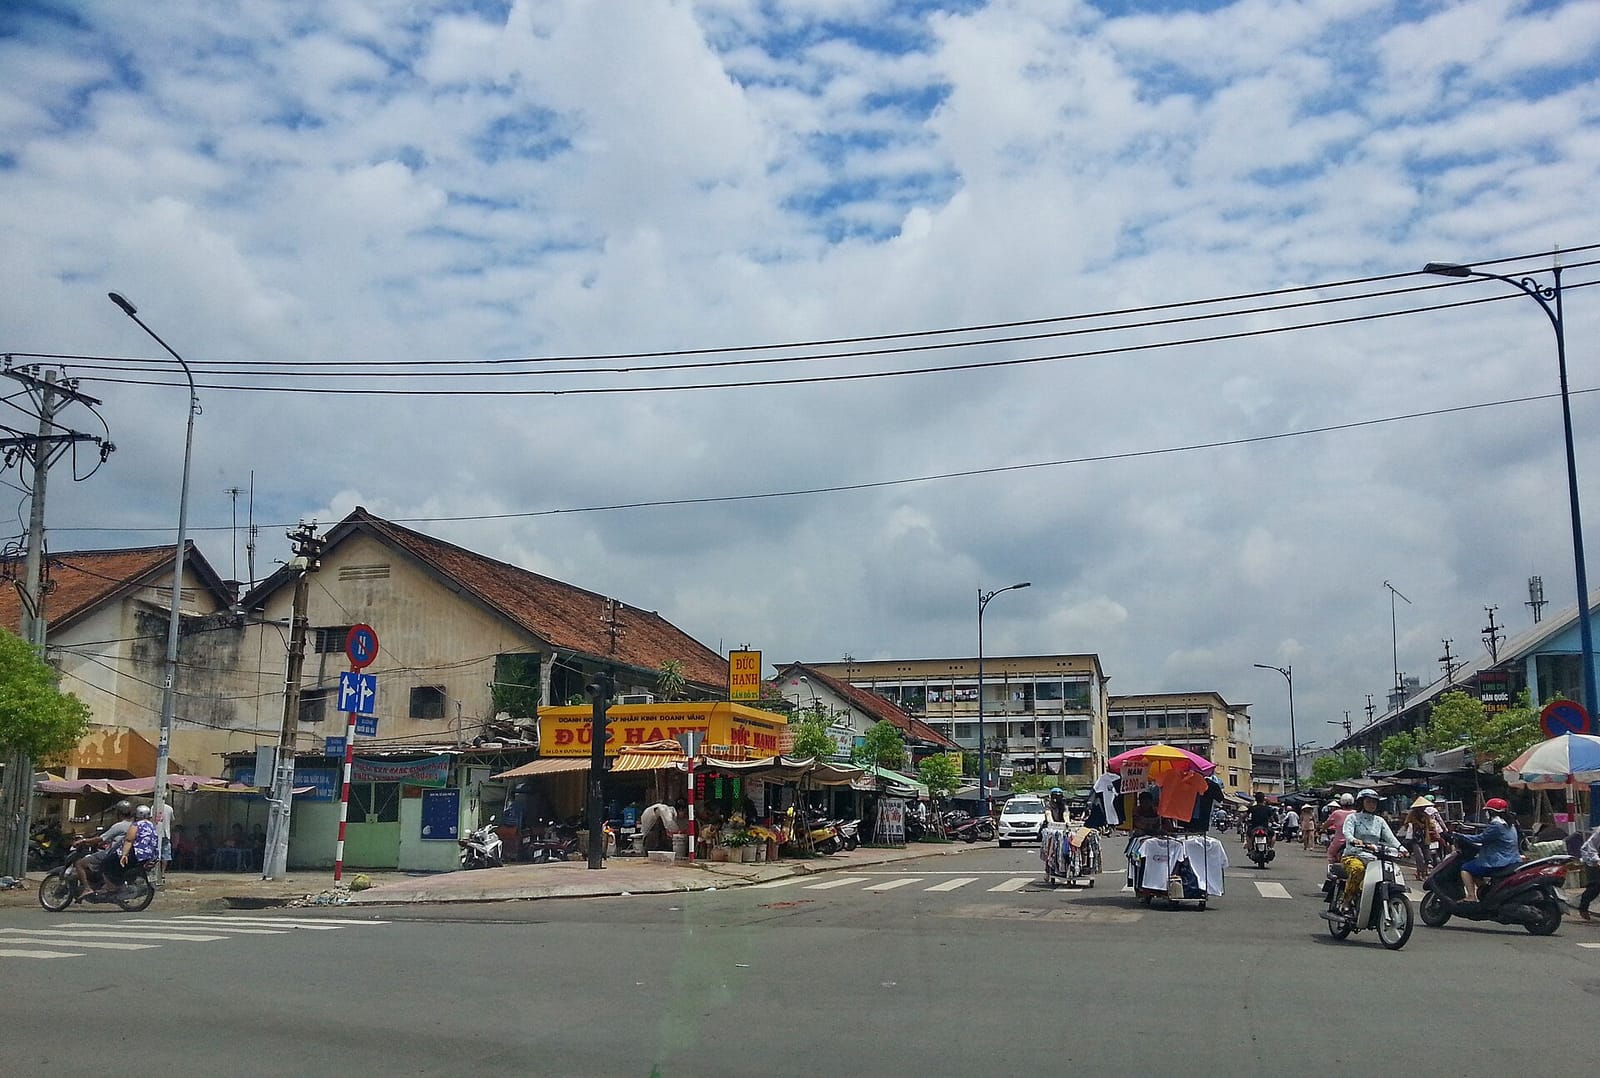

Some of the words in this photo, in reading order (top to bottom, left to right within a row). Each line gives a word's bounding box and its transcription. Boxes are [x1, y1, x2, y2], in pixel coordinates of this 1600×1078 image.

[736, 655, 755, 670] ĐỨC
[732, 673, 758, 687] HẠNH
[620, 714, 639, 722] NHÂN
